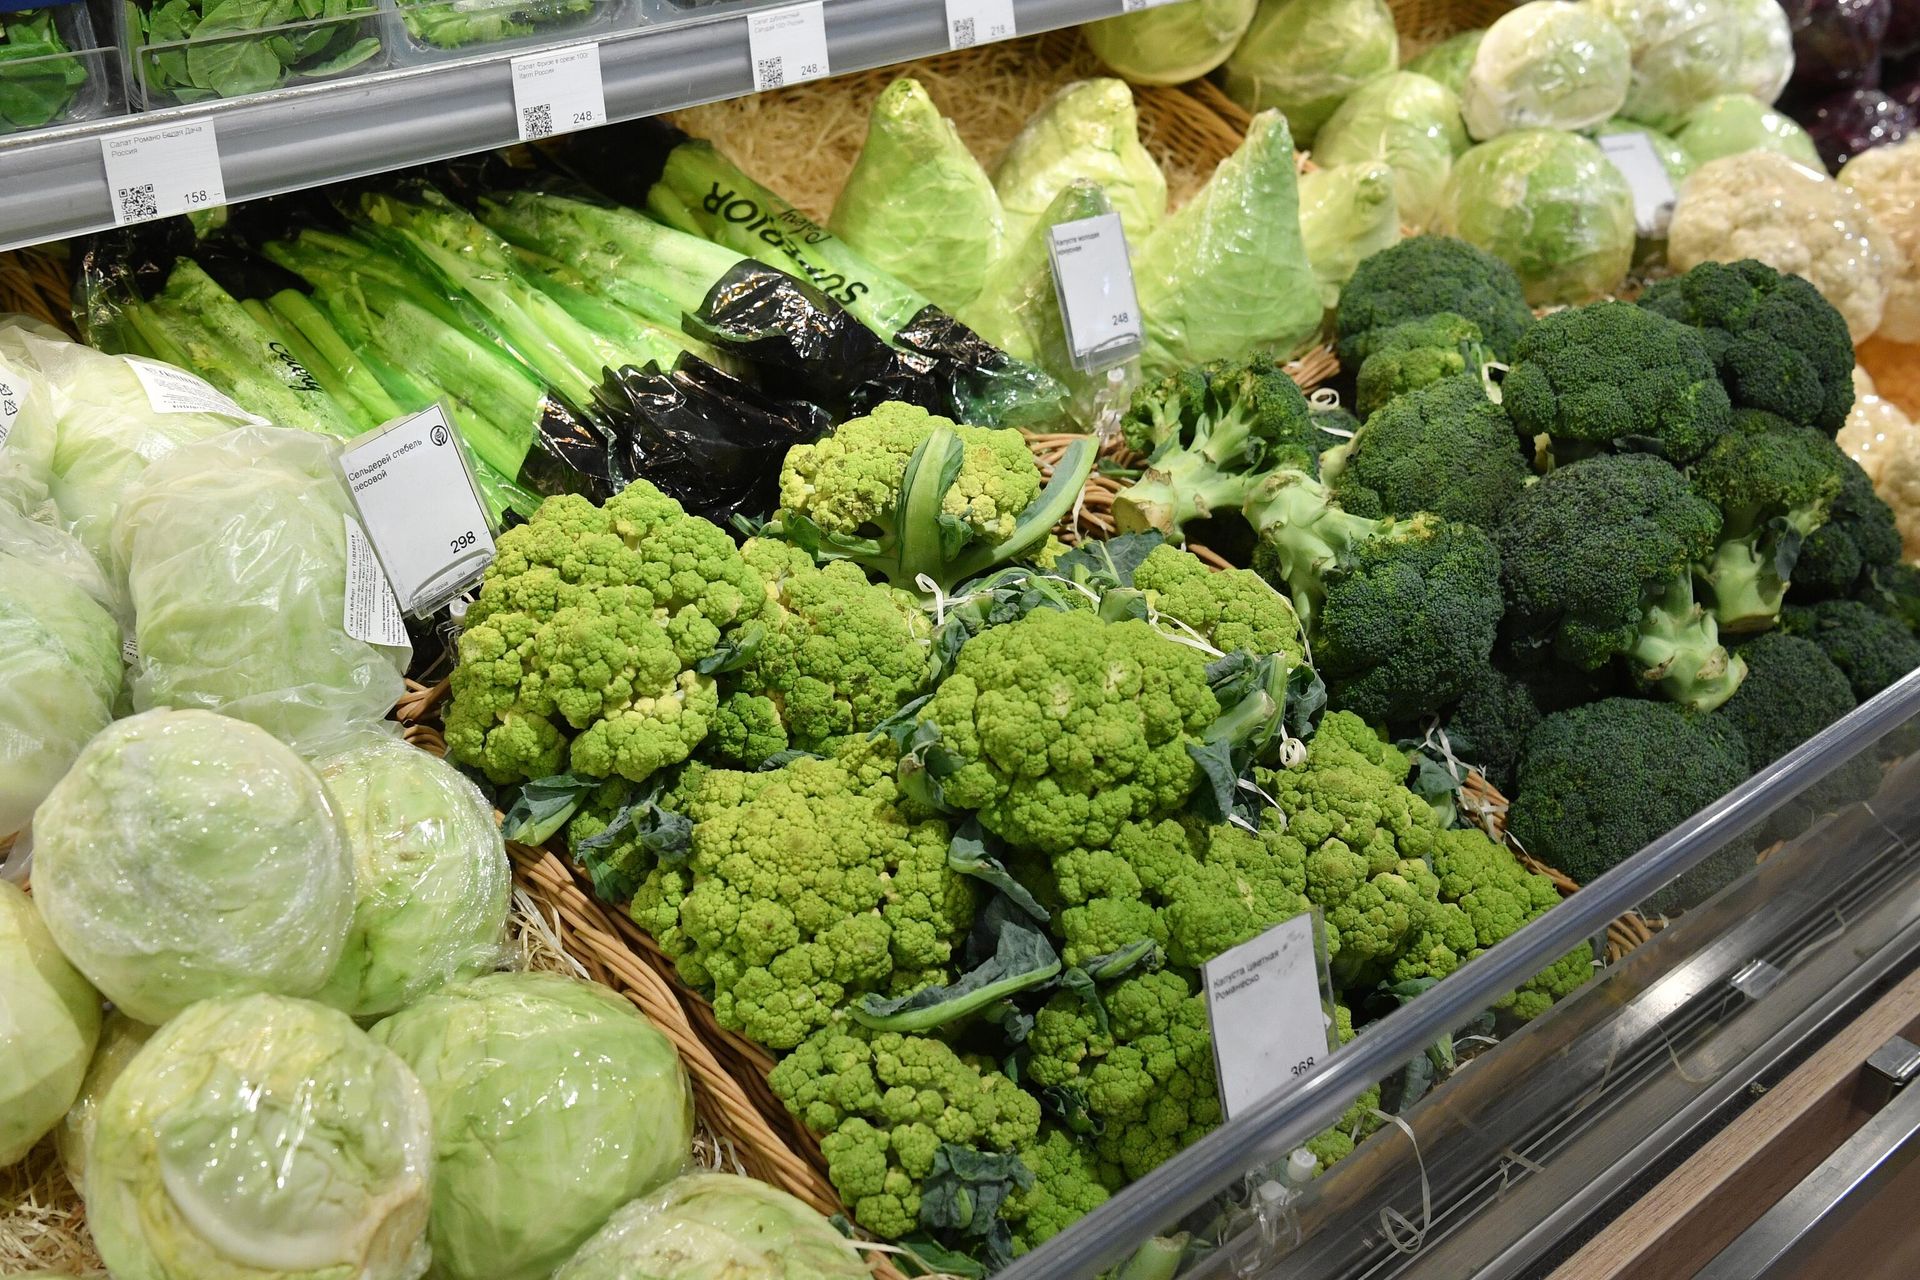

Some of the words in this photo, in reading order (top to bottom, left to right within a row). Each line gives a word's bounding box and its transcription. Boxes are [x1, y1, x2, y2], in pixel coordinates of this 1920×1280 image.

[518, 63, 535, 72] Салат
[109, 140, 131, 149] Салат
[134, 134, 161, 144] Романо
[162, 130, 183, 139] Белая
[184, 126, 203, 136] Дача
[111, 147, 138, 158] Россия
[703, 181, 869, 306] SUERIOR
[1112, 312, 1129, 326] 248
[348, 453, 392, 482] Сельдерей
[392, 438, 423, 460] стебель
[353, 470, 388, 493] весовой
[1213, 966, 1246, 989] Капуста
[1246, 950, 1279, 973] цветная
[1215, 974, 1260, 1002] Романеско
